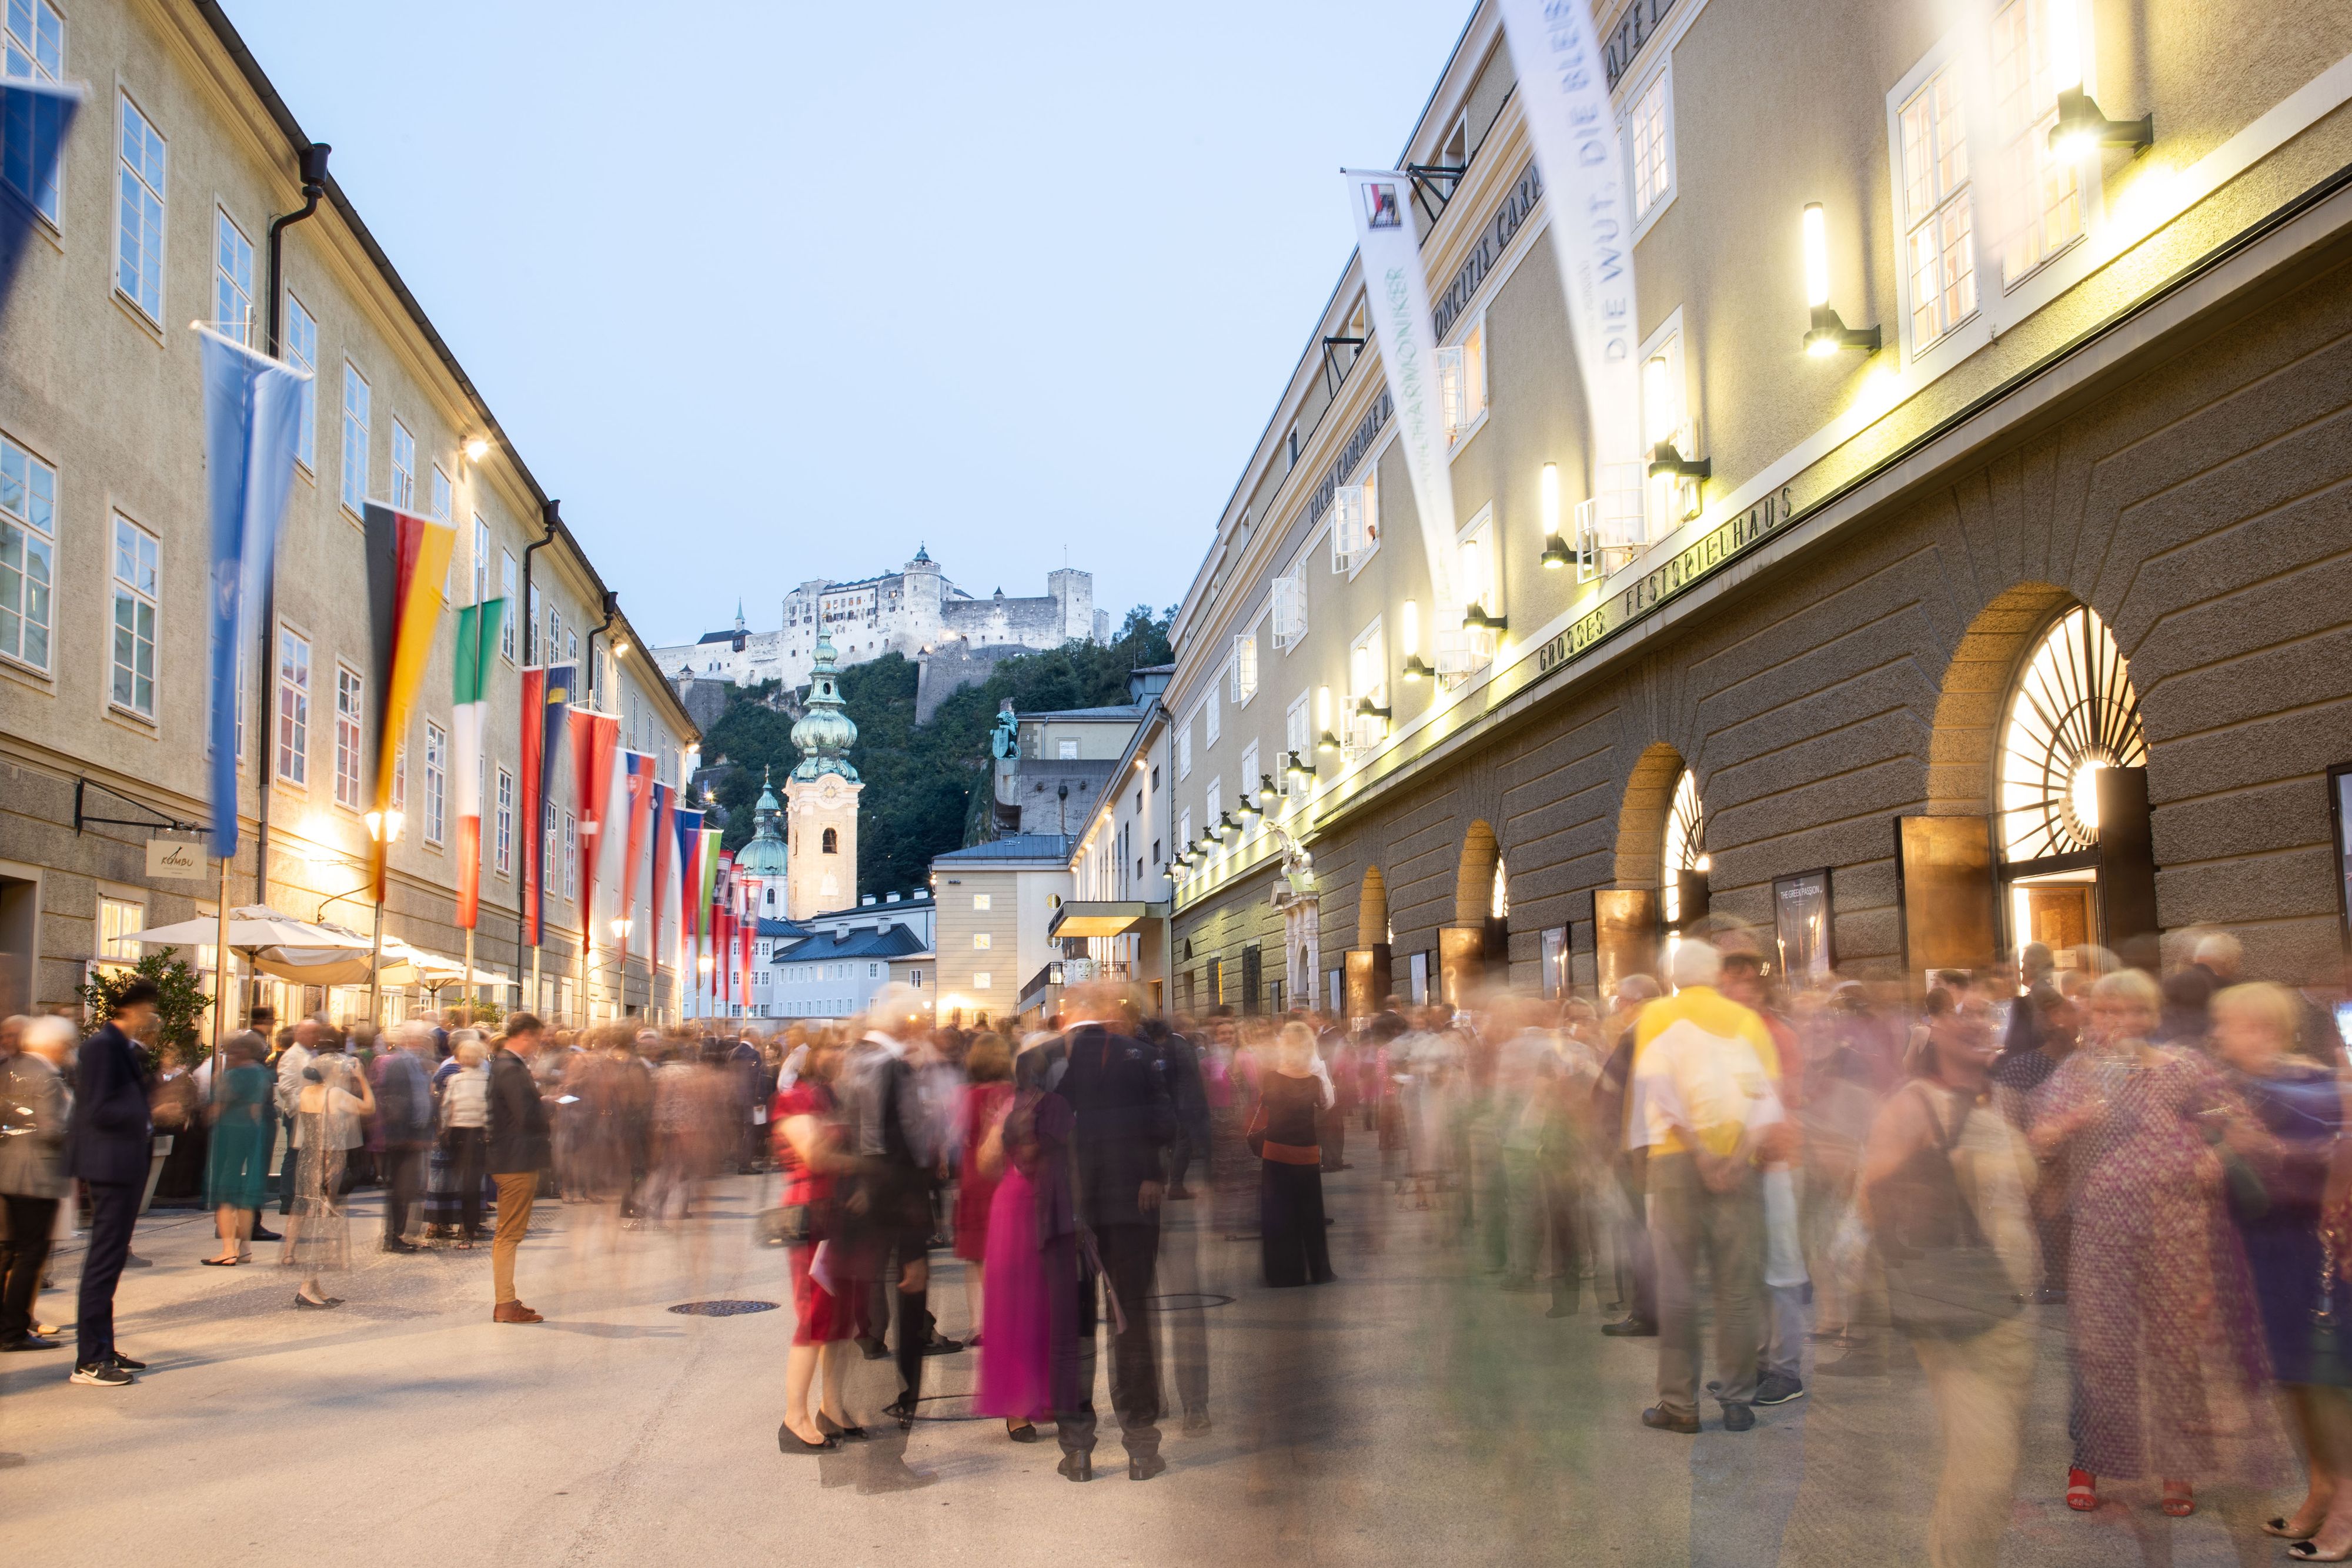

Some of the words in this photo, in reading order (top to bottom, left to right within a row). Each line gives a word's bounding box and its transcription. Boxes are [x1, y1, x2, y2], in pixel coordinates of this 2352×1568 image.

[1539, 0, 1591, 93] BLEIB
[1569, 103, 1608, 167] DIE
[1434, 236, 1489, 340] ONCITIS
[1602, 297, 1628, 365] DIE
[1539, 610, 1605, 671] GROSSES
[1626, 487, 1792, 616] FESTSPIELHAUS
[1788, 888, 1801, 898] GREEK
[1801, 885, 1819, 895] PASSION
